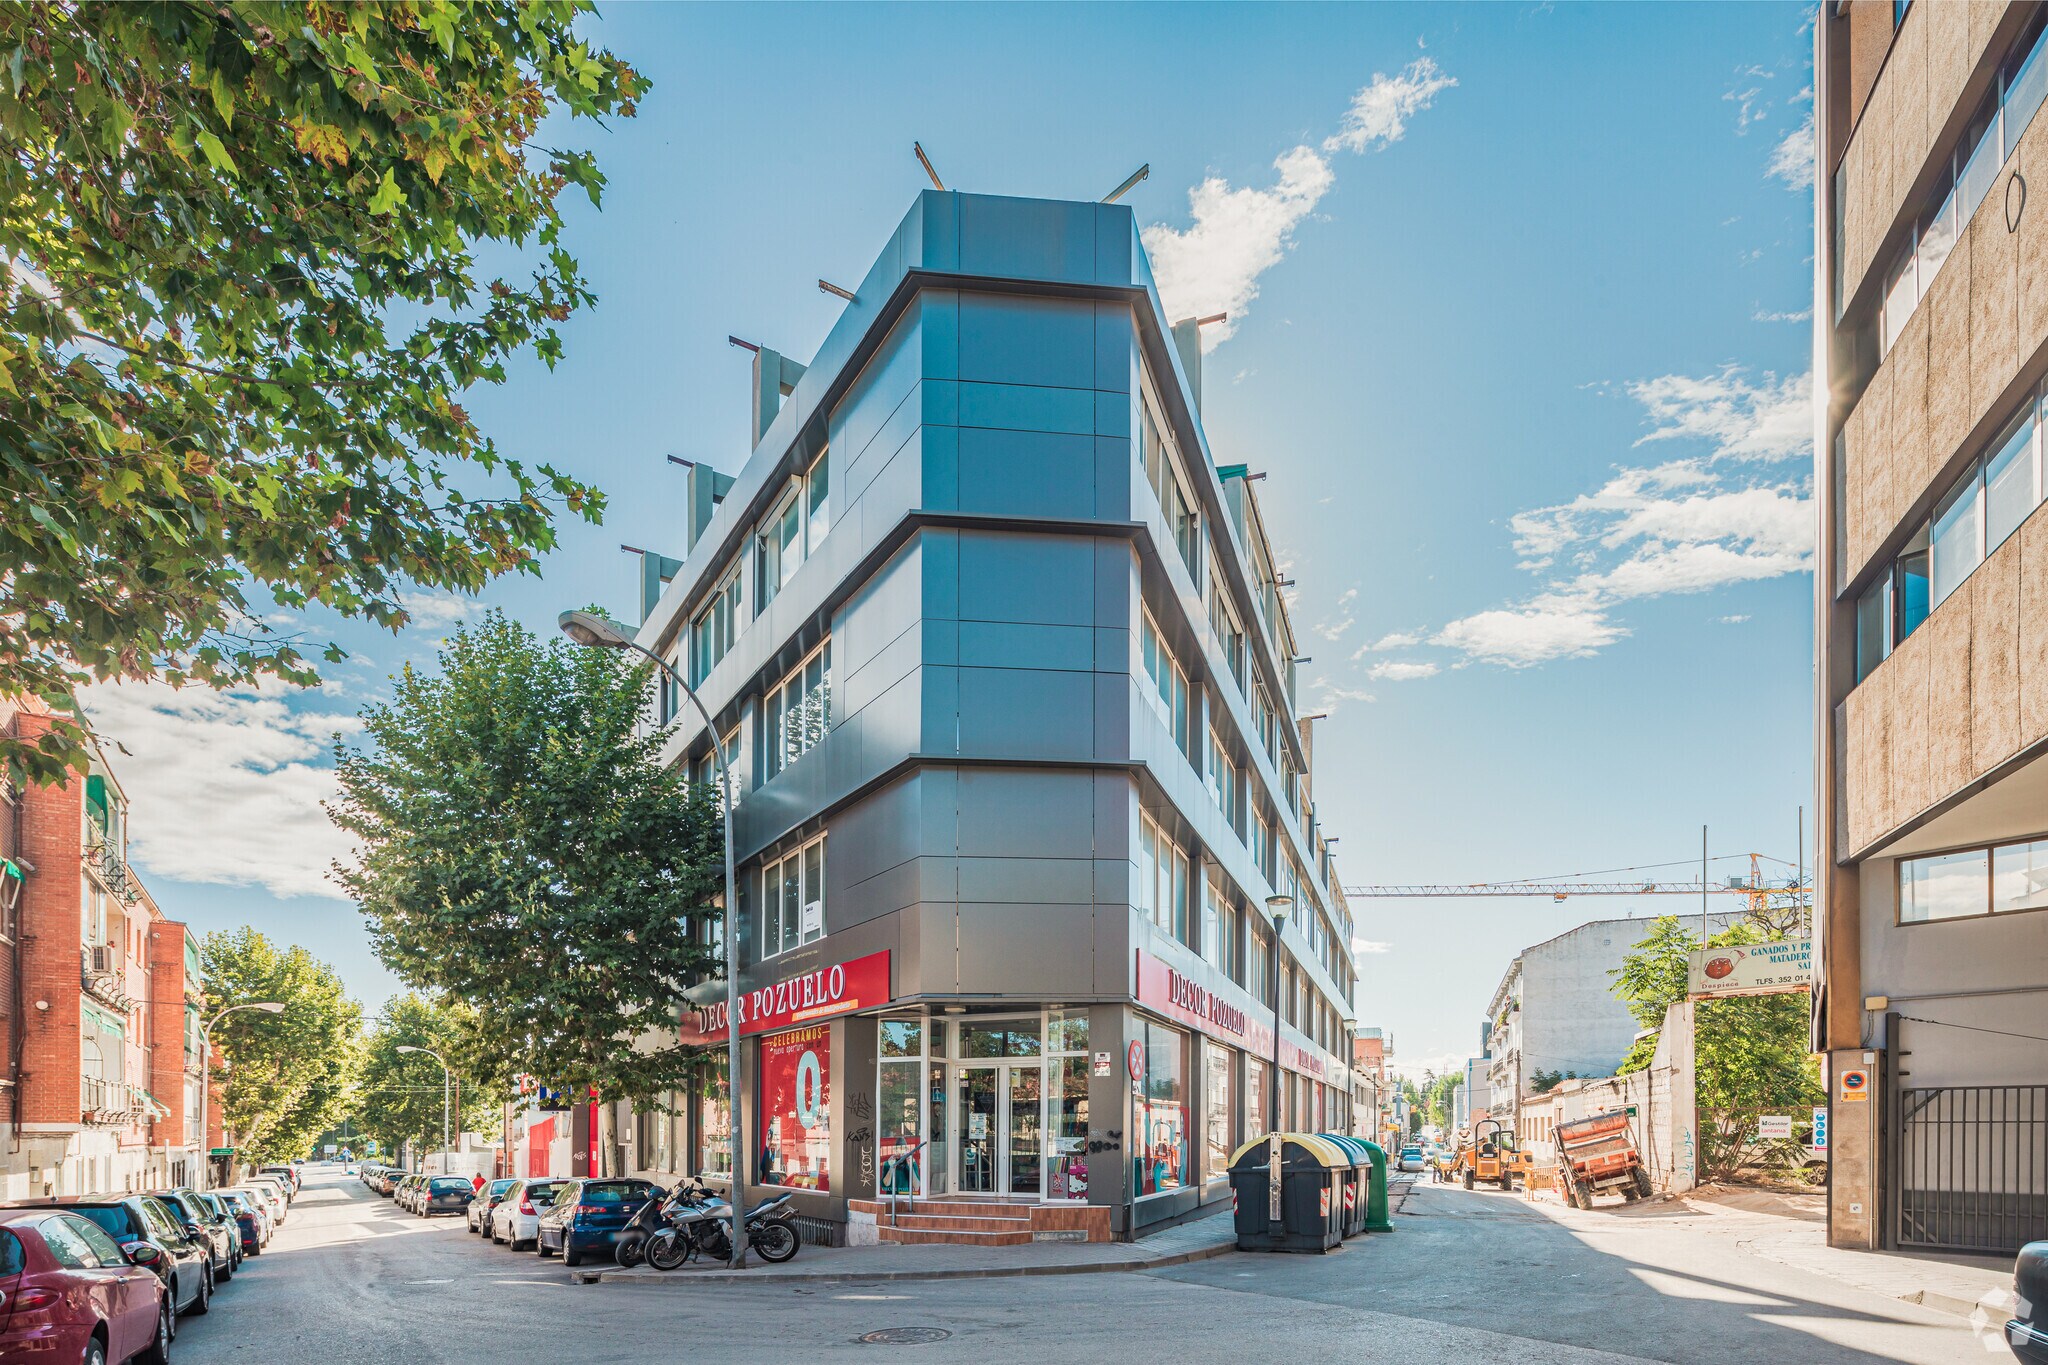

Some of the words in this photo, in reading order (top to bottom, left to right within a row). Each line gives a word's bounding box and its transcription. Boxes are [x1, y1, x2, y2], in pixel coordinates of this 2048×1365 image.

[1751, 945, 1789, 957] GANADOS
[1791, 944, 1798, 952] Y
[1702, 982, 1739, 990] Despiece
[1778, 975, 1792, 983] 352
[699, 996, 746, 1034] DECR
[753, 964, 845, 1021] POZUELO
[1169, 969, 1207, 1018] DECOR
[1209, 993, 1245, 1036] POZUELO
[773, 1027, 822, 1047] CELEBRAMOS
